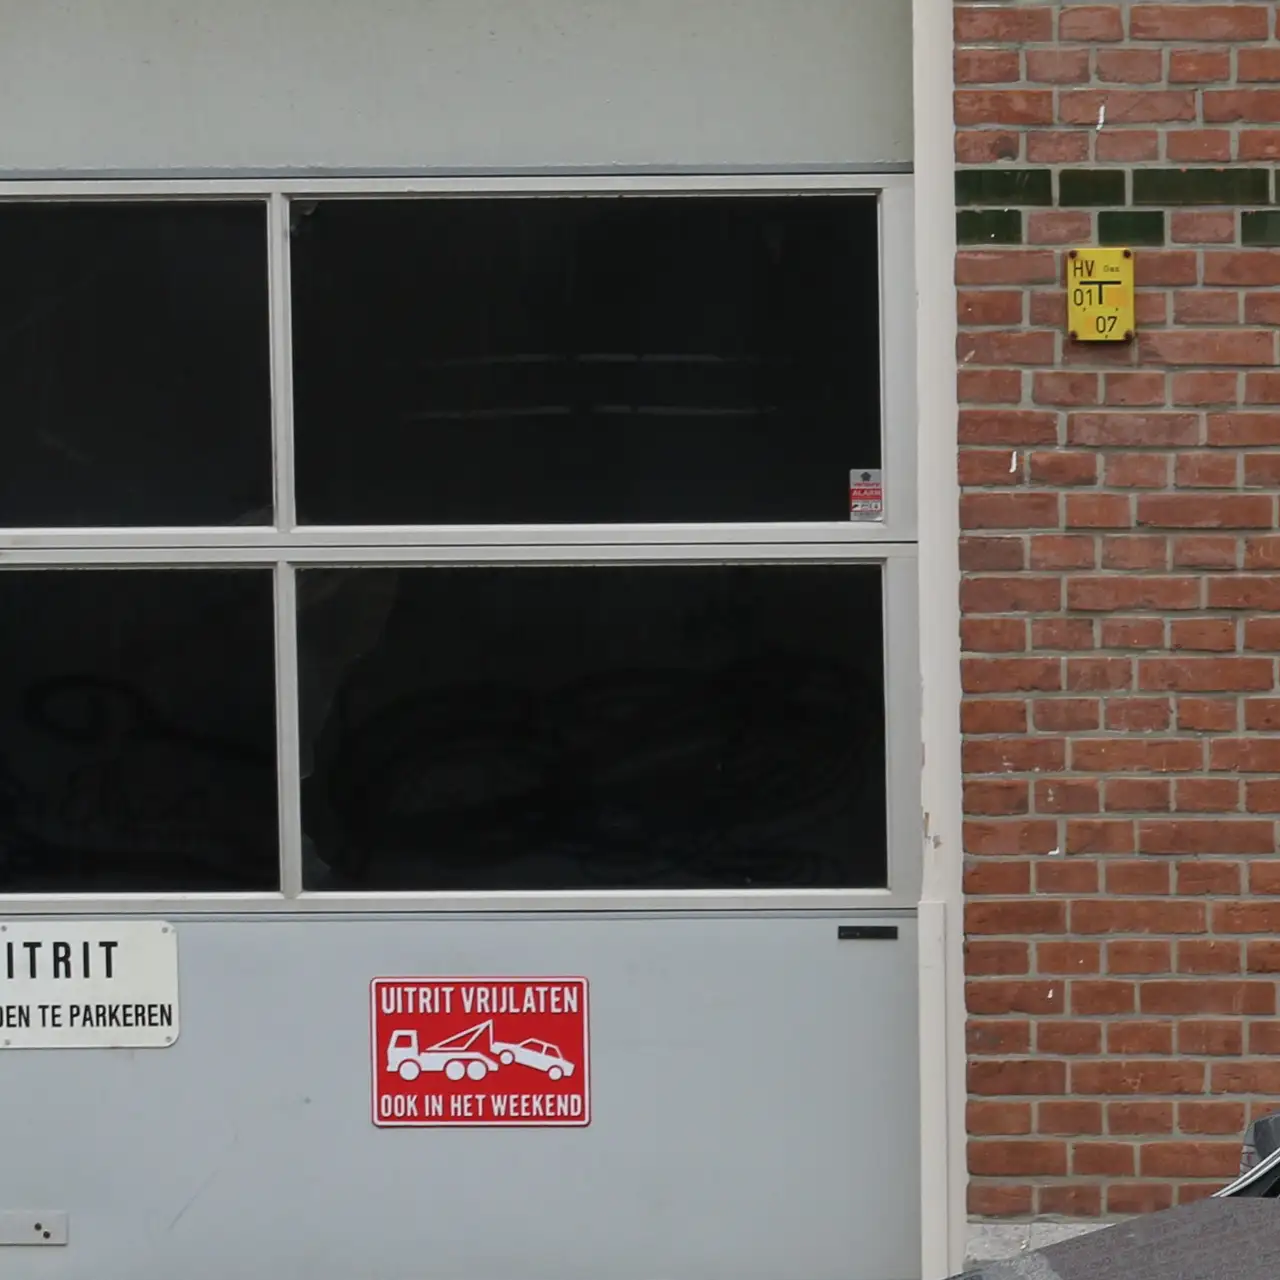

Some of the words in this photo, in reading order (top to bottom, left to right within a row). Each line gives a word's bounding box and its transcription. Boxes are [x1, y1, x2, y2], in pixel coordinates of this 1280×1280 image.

[1073, 260, 1095, 277] HV
[381, 986, 454, 1015] UITRIT
[461, 986, 578, 1014] VRIJLATEN
[38, 1005, 63, 1027] TE
[69, 1004, 173, 1027] PARKEREN
[380, 1094, 418, 1117] OOK
[424, 1094, 443, 1117] IN
[451, 1094, 486, 1117] HET
[491, 1094, 582, 1117] WEEKEND
